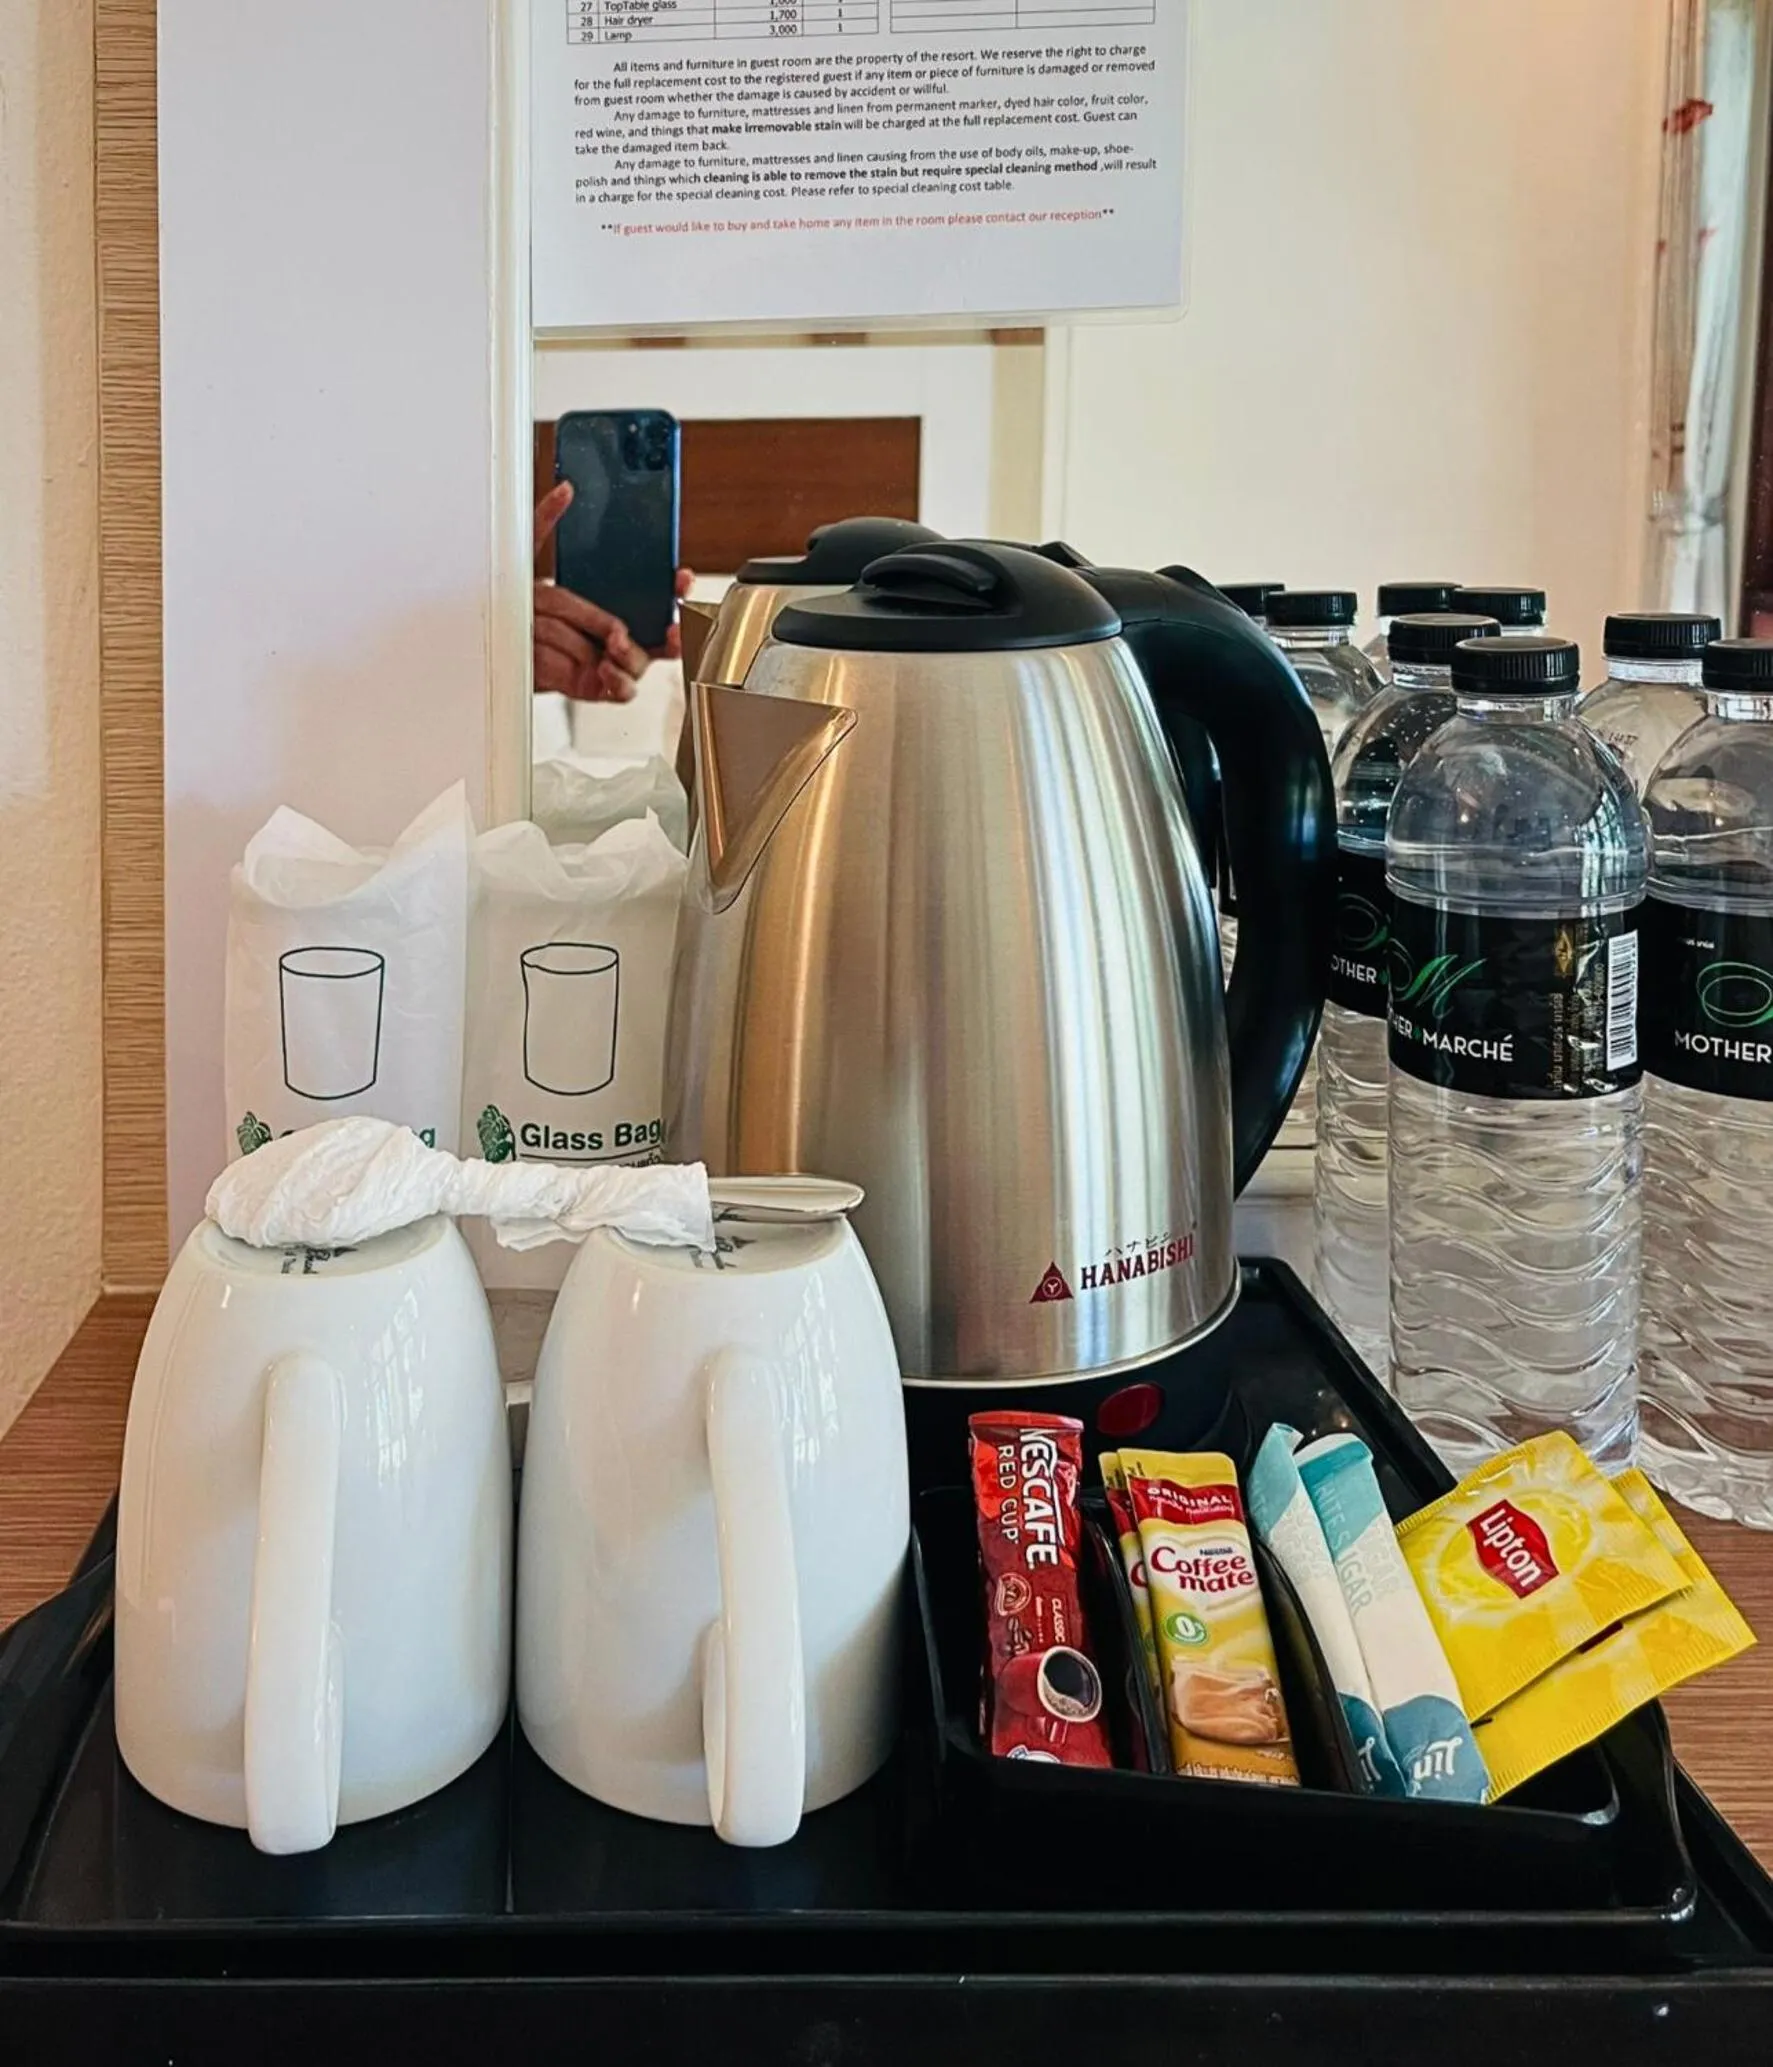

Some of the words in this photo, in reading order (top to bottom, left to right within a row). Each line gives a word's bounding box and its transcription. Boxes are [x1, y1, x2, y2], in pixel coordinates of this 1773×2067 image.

[580, 2, 592, 12] 27
[652, 0, 677, 11] glass
[580, 16, 592, 26] 28
[604, 15, 625, 25] Hair
[627, 15, 653, 27] dryer
[770, 10, 797, 21] 1,700
[604, 31, 632, 42] Lamp
[769, 24, 797, 37] 3,000
[613, 61, 627, 72] All
[631, 63, 660, 72] items
[663, 60, 683, 71] and
[686, 59, 734, 70] furniture
[737, 58, 747, 68] in
[750, 58, 779, 70] guest
[782, 58, 812, 67] room
[815, 57, 832, 66] are
[835, 55, 853, 65] the
[856, 54, 903, 65] property
[906, 50, 918, 63] of
[921, 51, 938, 62] the
[941, 51, 977, 61] resort.
[981, 49, 999, 60] We
[1002, 49, 1042, 59] reserve
[1046, 47, 1063, 58] the
[1066, 46, 1092, 59] right
[1095, 46, 1106, 56] to
[1109, 45, 1146, 57] charge
[574, 79, 589, 90] for
[593, 80, 611, 90] the
[614, 78, 631, 89] full
[634, 77, 701, 88] replacement
[704, 76, 726, 86] cost
[730, 75, 741, 85] to
[744, 74, 762, 85] the
[765, 73, 820, 85] registered
[823, 72, 852, 83] guest
[855, 69, 862, 80] if
[865, 72, 884, 81] any
[887, 69, 912, 80] item
[915, 70, 926, 79] or
[930, 69, 959, 80] piece
[961, 65, 973, 78] of
[976, 65, 1024, 76] furniture
[1027, 65, 1035, 75] is
[1038, 63, 1089, 75] damaged
[1091, 64, 1103, 72] or
[1106, 61, 1155, 72] removed
[575, 128, 593, 139] red
[596, 128, 625, 138] wine,
[628, 126, 648, 138] and
[651, 126, 684, 137] things
[687, 125, 709, 135] that
[712, 123, 742, 134] make
[745, 121, 812, 133] irremovable
[814, 120, 842, 131] stain
[844, 118, 863, 130] will
[866, 119, 879, 130] be
[882, 117, 926, 130] charged
[929, 118, 939, 128] at
[942, 117, 960, 127] the
[963, 114, 981, 127] full
[983, 114, 1052, 126] replacement
[1055, 113, 1080, 124] cost.
[1083, 112, 1115, 122] Guest
[1118, 112, 1137, 121] can
[575, 145, 598, 155] take
[601, 144, 619, 154] the
[622, 143, 671, 154] damaged
[675, 143, 699, 152] item
[702, 140, 729, 151] back.
[615, 160, 635, 171] Any
[638, 159, 681, 170] damage
[684, 159, 695, 168] to
[698, 157, 749, 167] furniture,
[752, 156, 811, 165] mattresses
[814, 153, 834, 164] and
[837, 153, 863, 163] linen
[866, 152, 907, 163] causing
[910, 150, 936, 160] from
[939, 149, 957, 159] the
[960, 150, 978, 159] use
[981, 147, 993, 158] of
[995, 147, 1022, 158] body
[1025, 145, 1047, 157] oils,
[1050, 146, 1100, 156] make-up,
[1104, 144, 1133, 154] shoe-
[576, 176, 608, 188] polish
[611, 176, 631, 186] and
[634, 175, 666, 187] things
[669, 173, 701, 184] which
[704, 172, 749, 184] cleaning
[752, 171, 761, 183] is
[763, 170, 787, 182] able
[790, 170, 802, 181] to
[804, 171, 847, 180] remove
[849, 168, 868, 179] the
[870, 167, 897, 178] stain
[900, 167, 919, 178] but
[922, 166, 962, 177] require
[965, 163, 1003, 176] special
[1006, 162, 1051, 174] cleaning
[1054, 160, 1098, 172] method
[1126, 159, 1156, 170] result
[624, 225, 653, 236] guest
[655, 222, 688, 232] would
[691, 221, 710, 232] like
[713, 222, 725, 232] to
[727, 221, 747, 232] buy
[750, 219, 770, 230] and
[773, 220, 796, 229] take
[799, 219, 830, 229] home
[833, 219, 852, 228] any
[855, 218, 879, 227] item
[882, 217, 892, 225] in
[896, 216, 913, 226] the
[916, 216, 945, 225] room
[948, 214, 983, 225] please
[986, 213, 1025, 223] contact
[1029, 213, 1047, 221] our
[1330, 954, 1377, 985] OTHER
[1422, 1034, 1514, 1062] MARCHÉ
[1674, 1029, 1772, 1064] MOTHER
[520, 1123, 603, 1150] Glass
[614, 1118, 662, 1148] Bag
[1080, 1232, 1193, 1289] HANABISHI
[998, 1445, 1016, 1489] RED
[1147, 1487, 1232, 1508] ORIGINAL
[1001, 1498, 1018, 1541] CUP
[1151, 1546, 1246, 1578] Coffee
[1479, 1508, 1544, 1588] Lipton
[1178, 1570, 1255, 1593] mate
